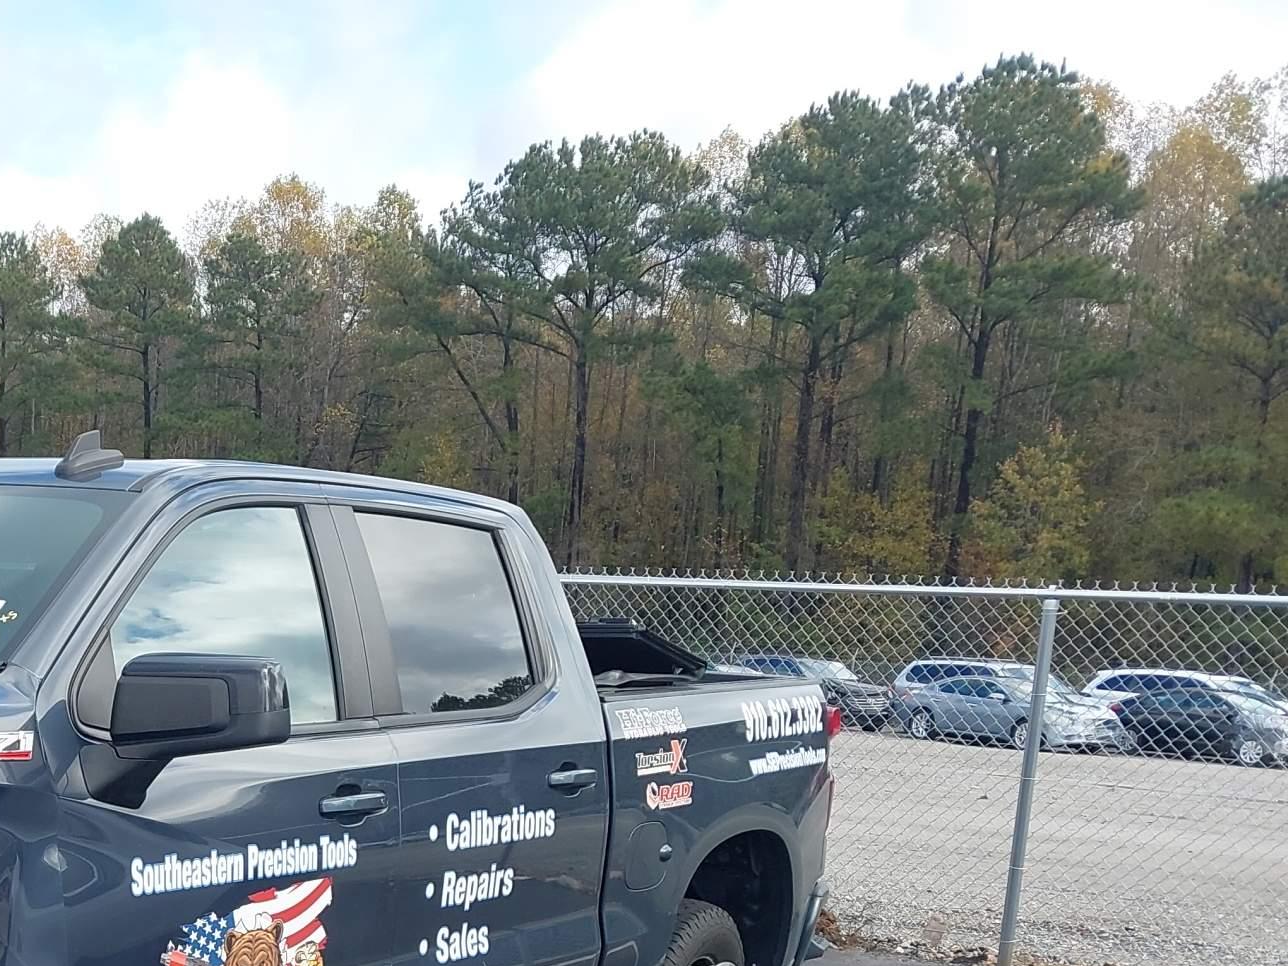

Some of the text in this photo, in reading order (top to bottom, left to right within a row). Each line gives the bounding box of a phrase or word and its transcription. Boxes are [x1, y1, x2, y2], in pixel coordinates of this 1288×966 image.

[742, 695, 824, 742] 910.612.3382
[659, 781, 692, 803] RAD
[446, 804, 555, 851] Calibrations
[131, 833, 357, 896] Southeastern Precision Tools
[441, 863, 514, 911] Repairs
[436, 922, 489, 963] Sales
